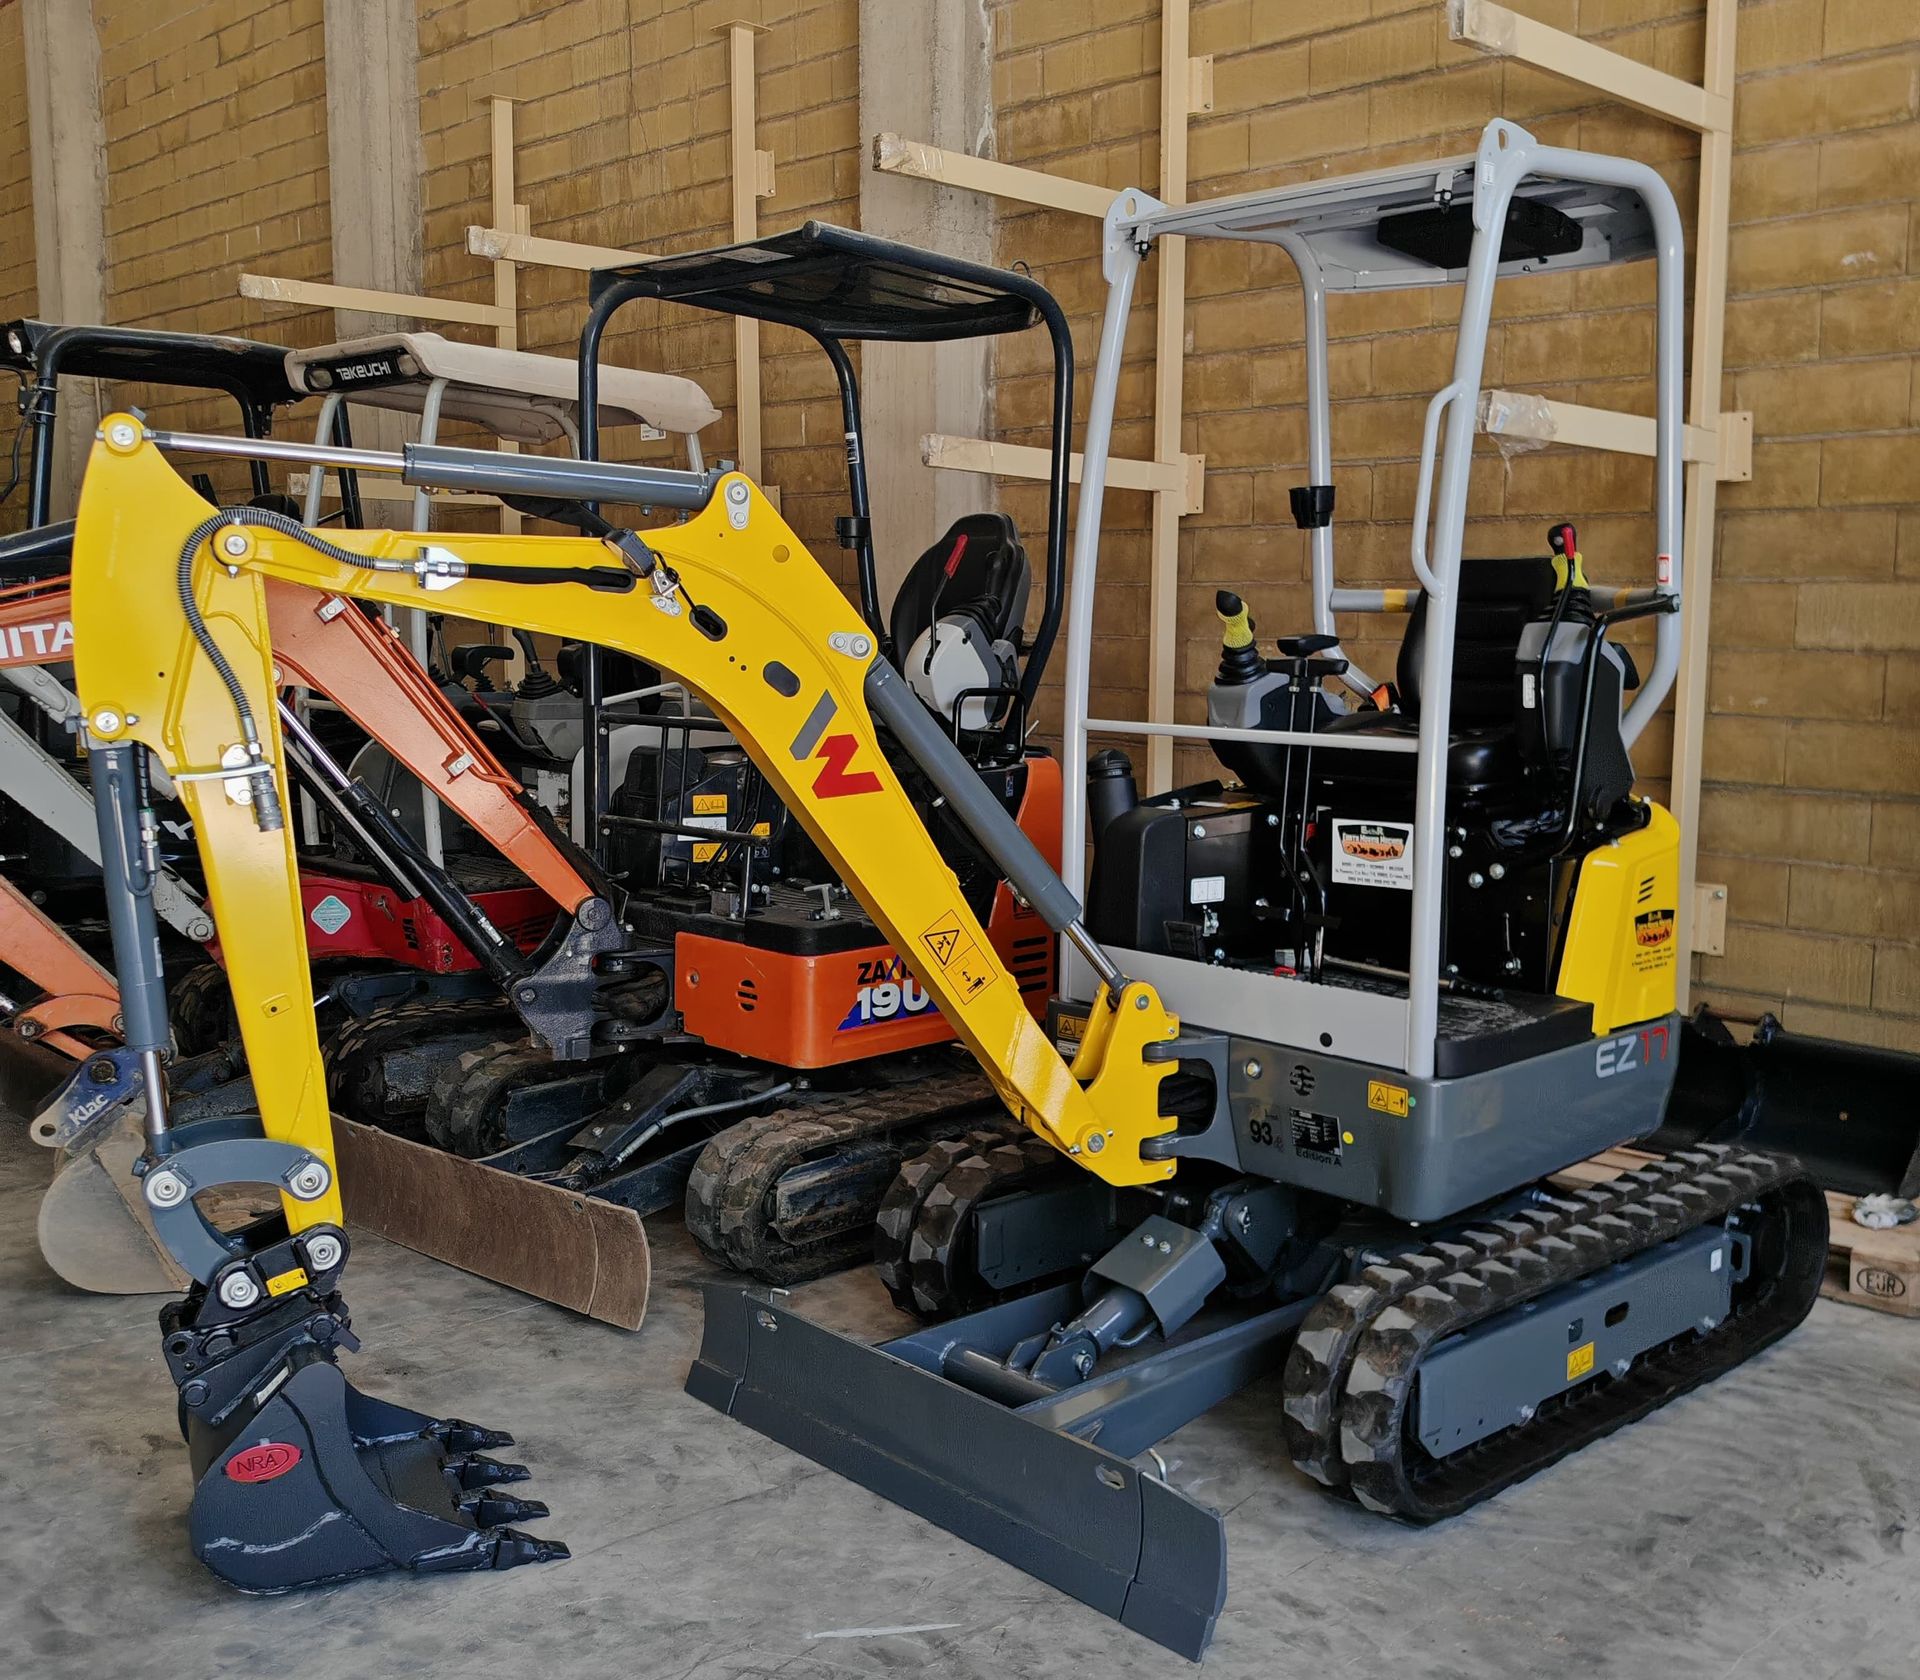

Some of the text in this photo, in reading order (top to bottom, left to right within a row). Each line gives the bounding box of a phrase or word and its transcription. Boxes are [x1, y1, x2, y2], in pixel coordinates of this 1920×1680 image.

[68, 1094, 109, 1127] Klac
[1250, 1119, 1272, 1145] 93
[1296, 1147, 1342, 1168] Edition A
[1866, 1271, 1897, 1293] EUR
[236, 1452, 279, 1474] NRA
